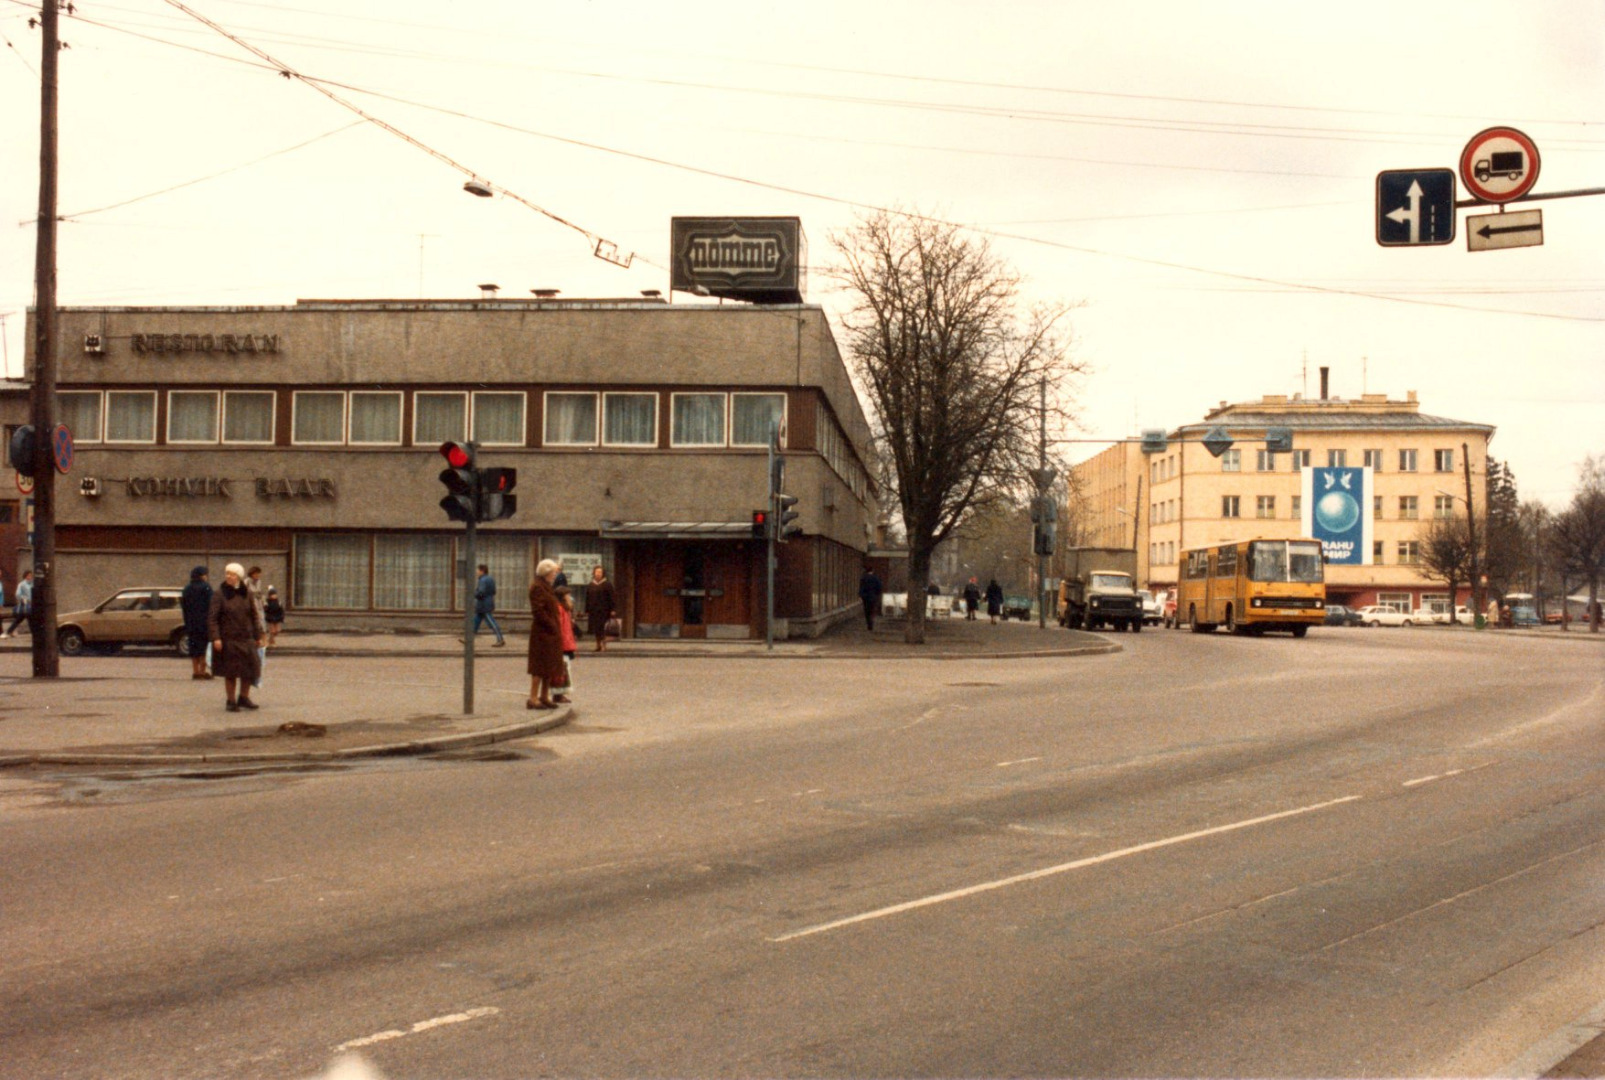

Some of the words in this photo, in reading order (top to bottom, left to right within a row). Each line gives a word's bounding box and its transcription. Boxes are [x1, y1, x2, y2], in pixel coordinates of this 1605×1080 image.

[131, 333, 281, 354] RESTORAN
[126, 476, 233, 498] KOHVIK
[255, 477, 335, 498] BAAR
[1321, 540, 1354, 550] RAHU
